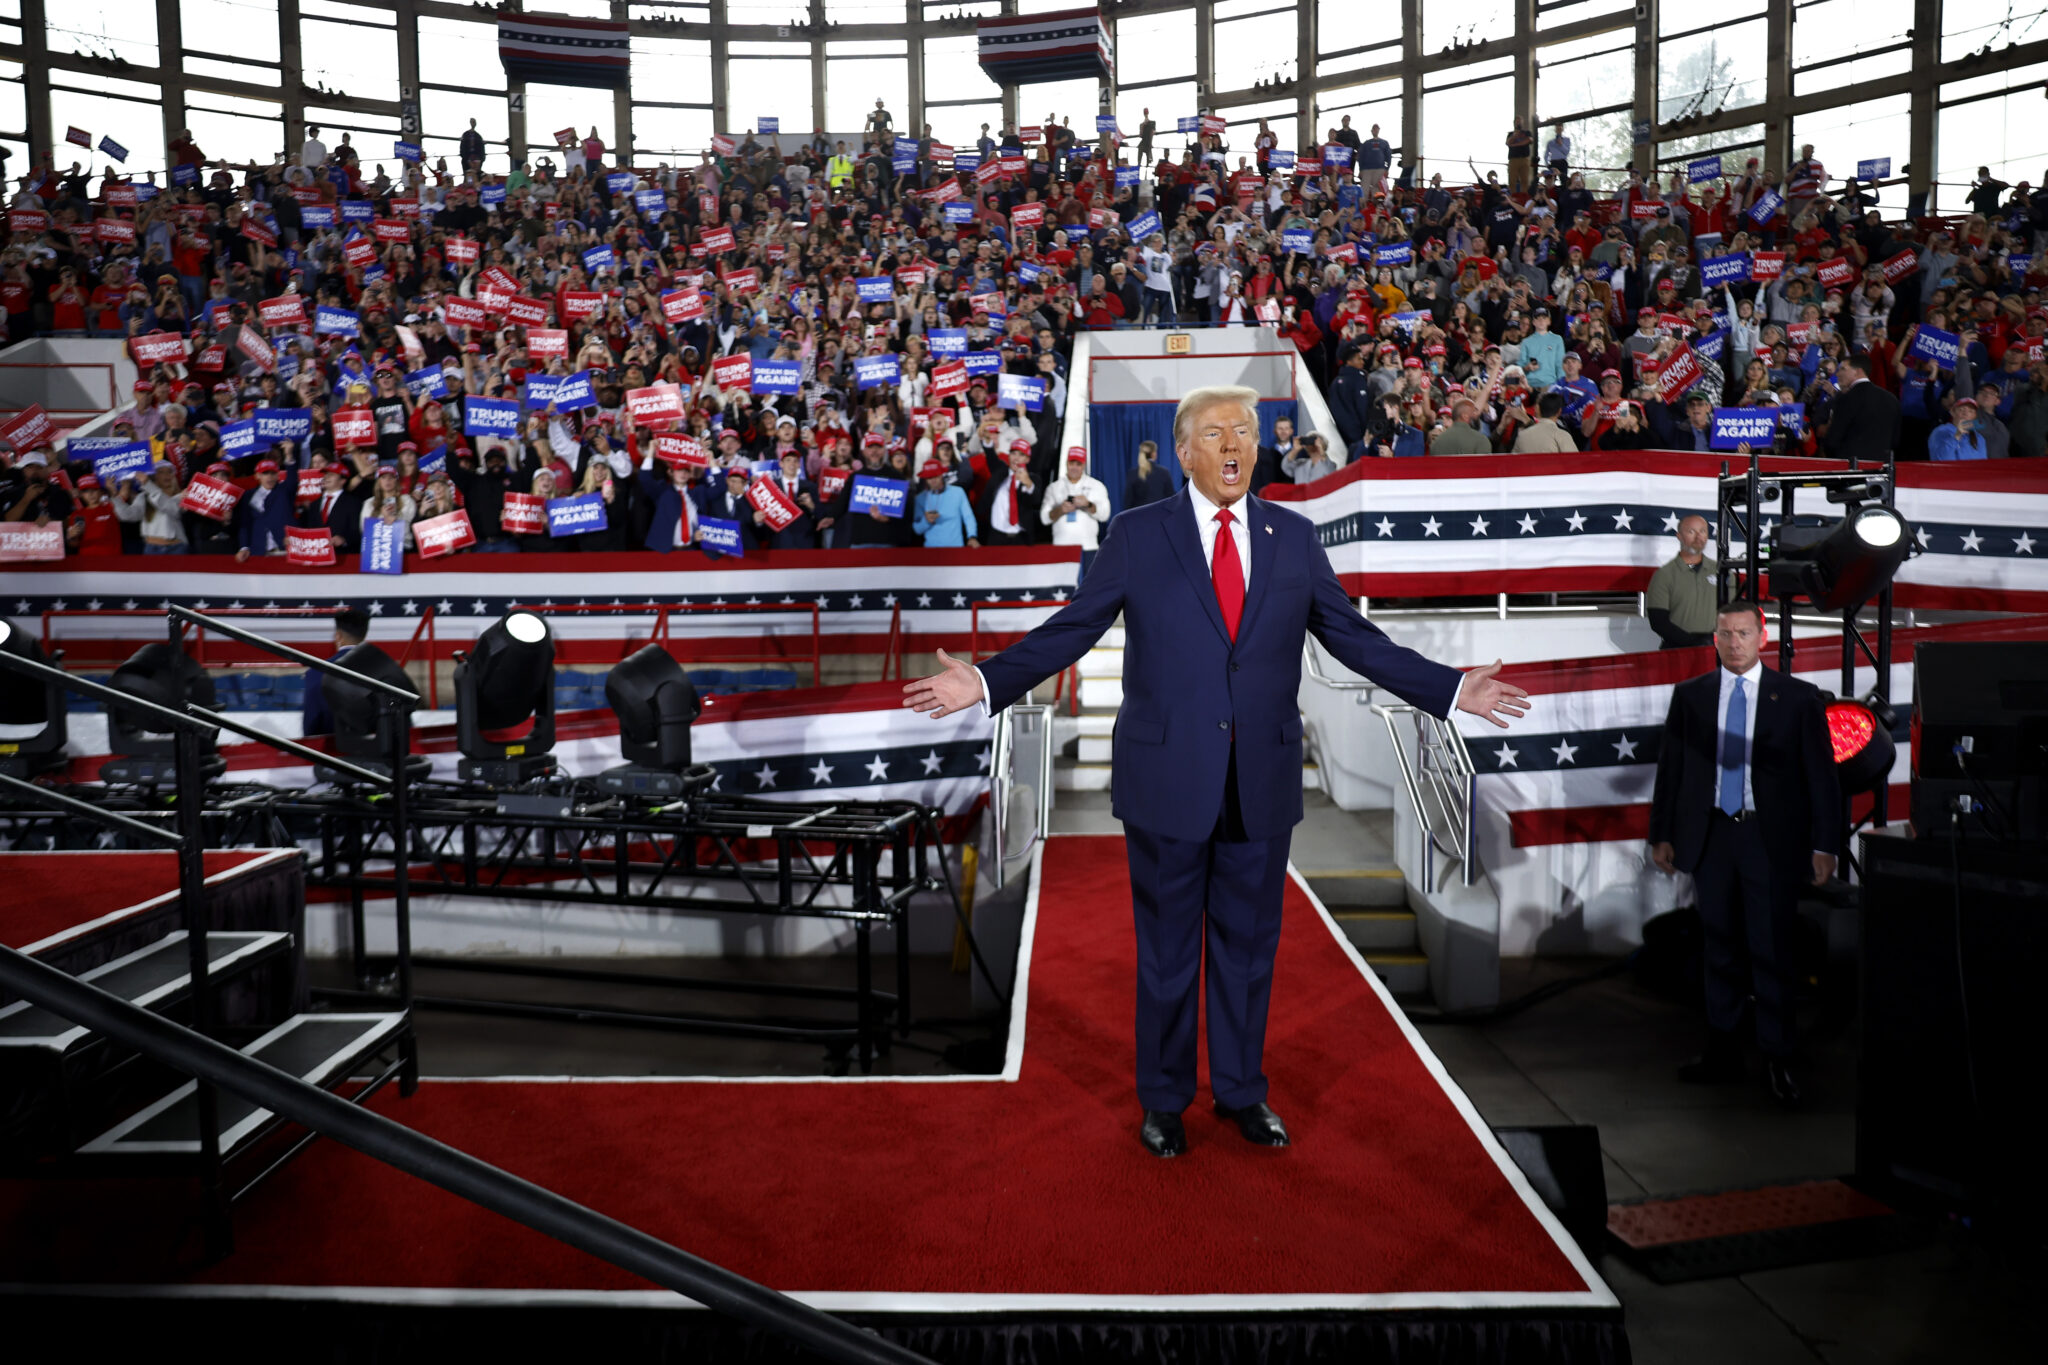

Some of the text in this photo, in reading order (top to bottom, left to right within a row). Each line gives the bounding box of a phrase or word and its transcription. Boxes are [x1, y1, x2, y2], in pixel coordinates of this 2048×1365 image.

[511, 94, 525, 112] 4
[1100, 88, 1111, 105] 4
[403, 115, 416, 134] 3
[1704, 262, 1728, 271] DREAM
[1755, 259, 1783, 268] TRUMP
[1705, 265, 1742, 279] AGAIN!
[263, 303, 300, 314] TRUMP
[665, 295, 699, 310] TRUMP
[449, 304, 485, 317] TRUMP
[510, 310, 545, 323] AGAIN!
[319, 312, 358, 325] TRUMP
[137, 341, 181, 353] TRUMP
[716, 362, 750, 376] TRUMP
[754, 367, 781, 375] DREAM
[1659, 353, 1690, 387] TRUMP
[755, 375, 796, 386] AGAIN!
[1663, 363, 1695, 393] WILL FIX IT
[469, 407, 518, 420] TRUMP
[635, 400, 679, 415] AGAIN!
[8, 413, 46, 439] TRUMP
[257, 418, 309, 430] TRUMP
[334, 421, 371, 431] TRUMP
[470, 419, 492, 427] WILL
[492, 420, 509, 428] FIX
[1717, 417, 1753, 427] DREAM
[1755, 417, 1774, 427] BIG,
[1717, 426, 1769, 438] AGAIN!
[223, 436, 255, 449] AGAI
[95, 452, 129, 466] DREAM
[99, 456, 147, 475] AGAIN!
[190, 482, 236, 503] TRUMP
[856, 485, 904, 498] TRUMP
[757, 481, 793, 520] TRUMP
[854, 495, 876, 504] WILL
[551, 502, 602, 515] DREAM BIG,
[553, 510, 600, 526] AGAIN!
[1, 532, 60, 543] TRUMP
[289, 536, 330, 548] TRUMP
[380, 524, 393, 569] AGAIN!
